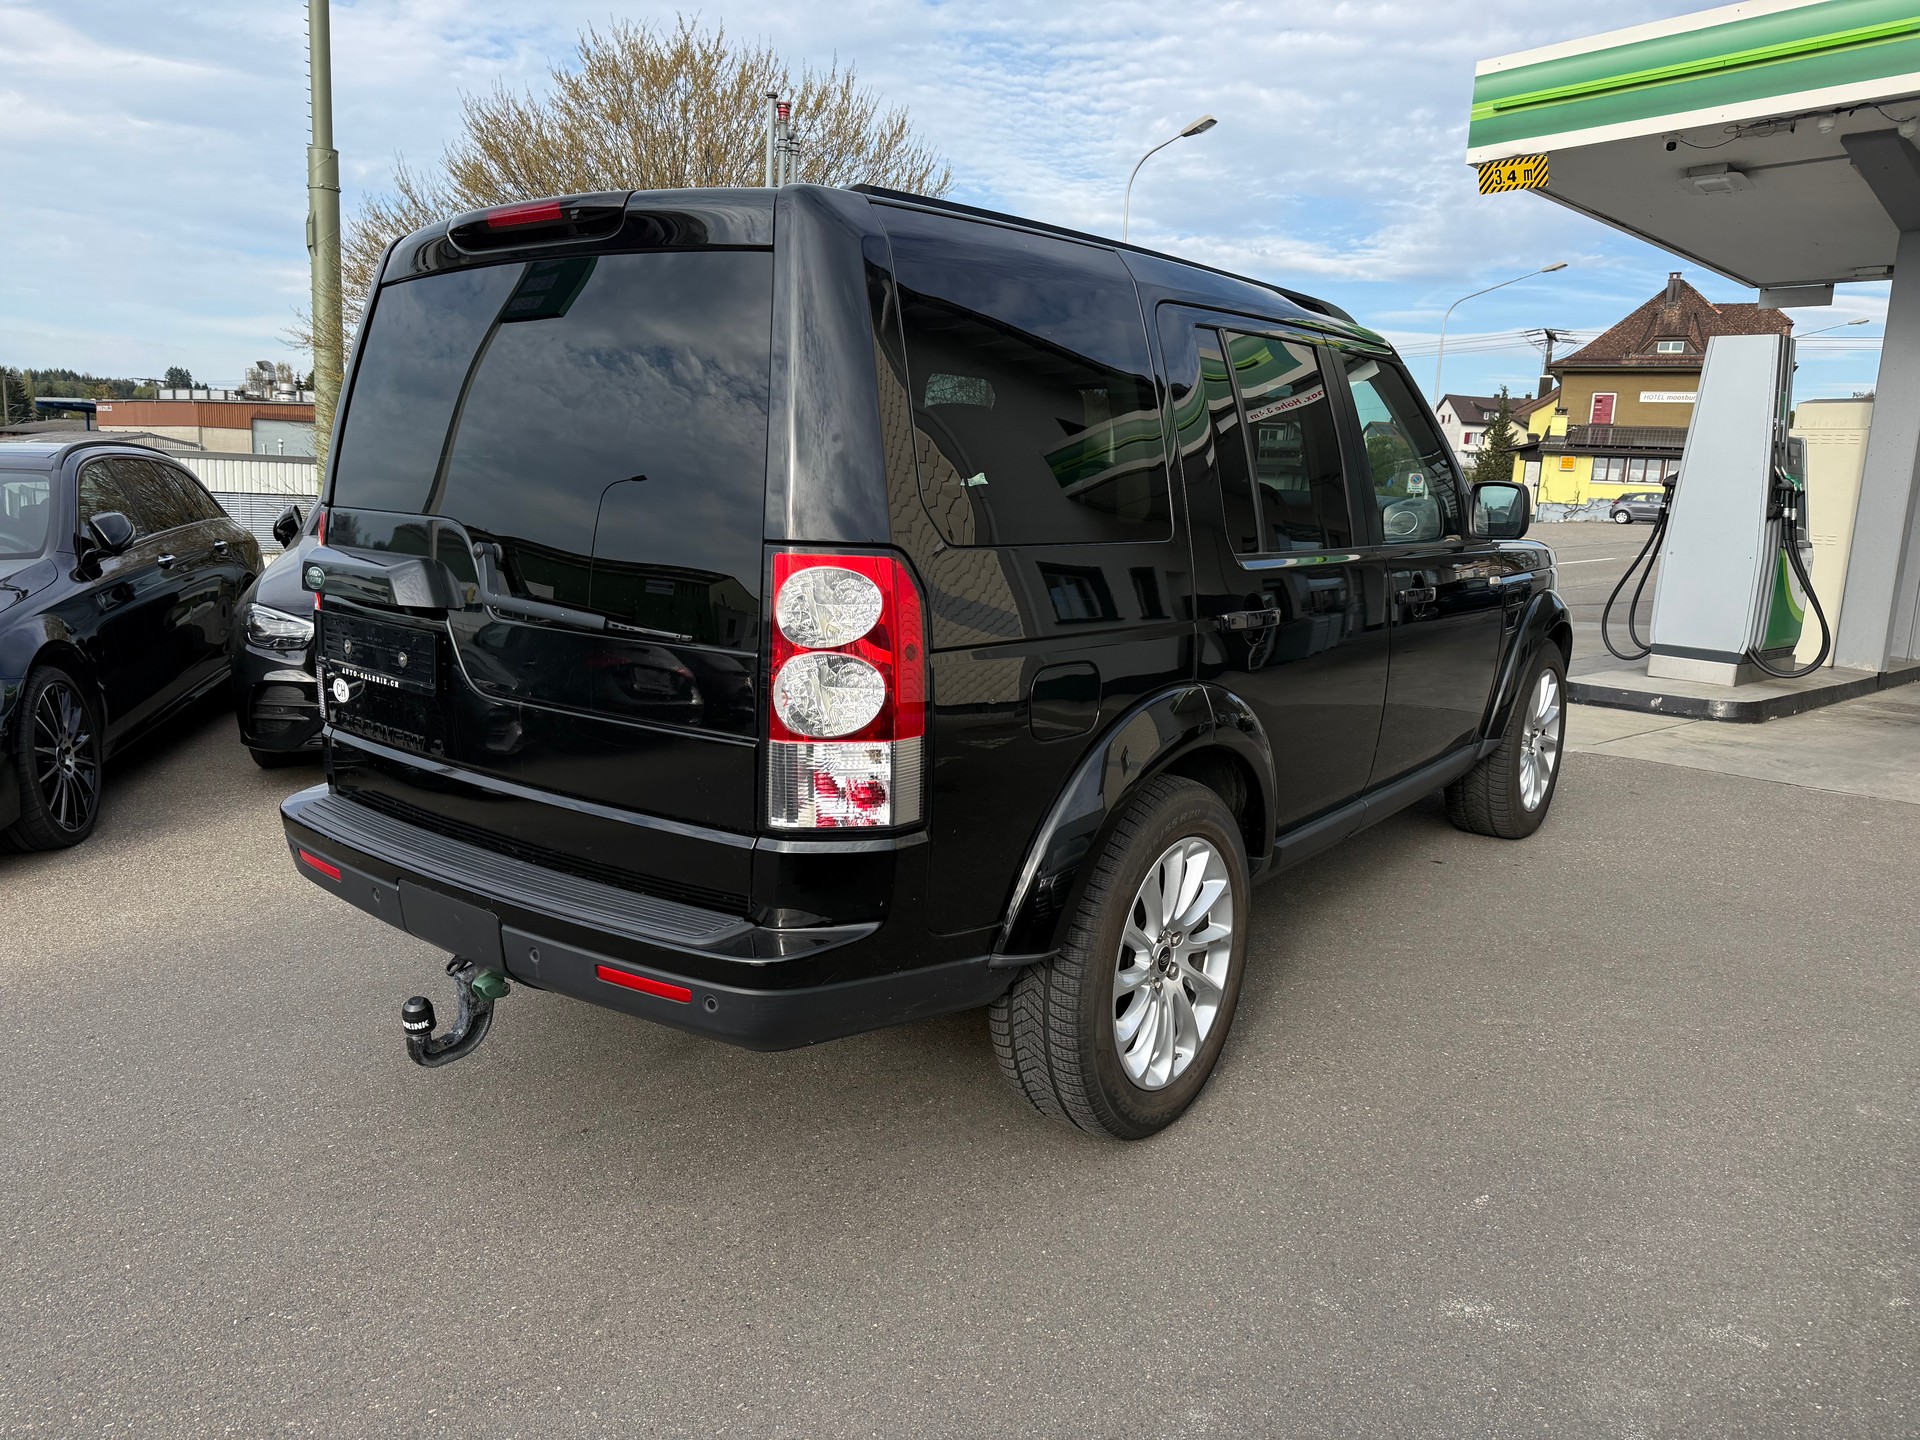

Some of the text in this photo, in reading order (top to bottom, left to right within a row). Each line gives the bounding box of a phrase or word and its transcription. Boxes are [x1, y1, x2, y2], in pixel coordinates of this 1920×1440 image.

[1495, 168, 1533, 185] 3.4 m
[341, 667, 399, 688] AUTO-GALERIE.CH
[336, 682, 346, 697] CH
